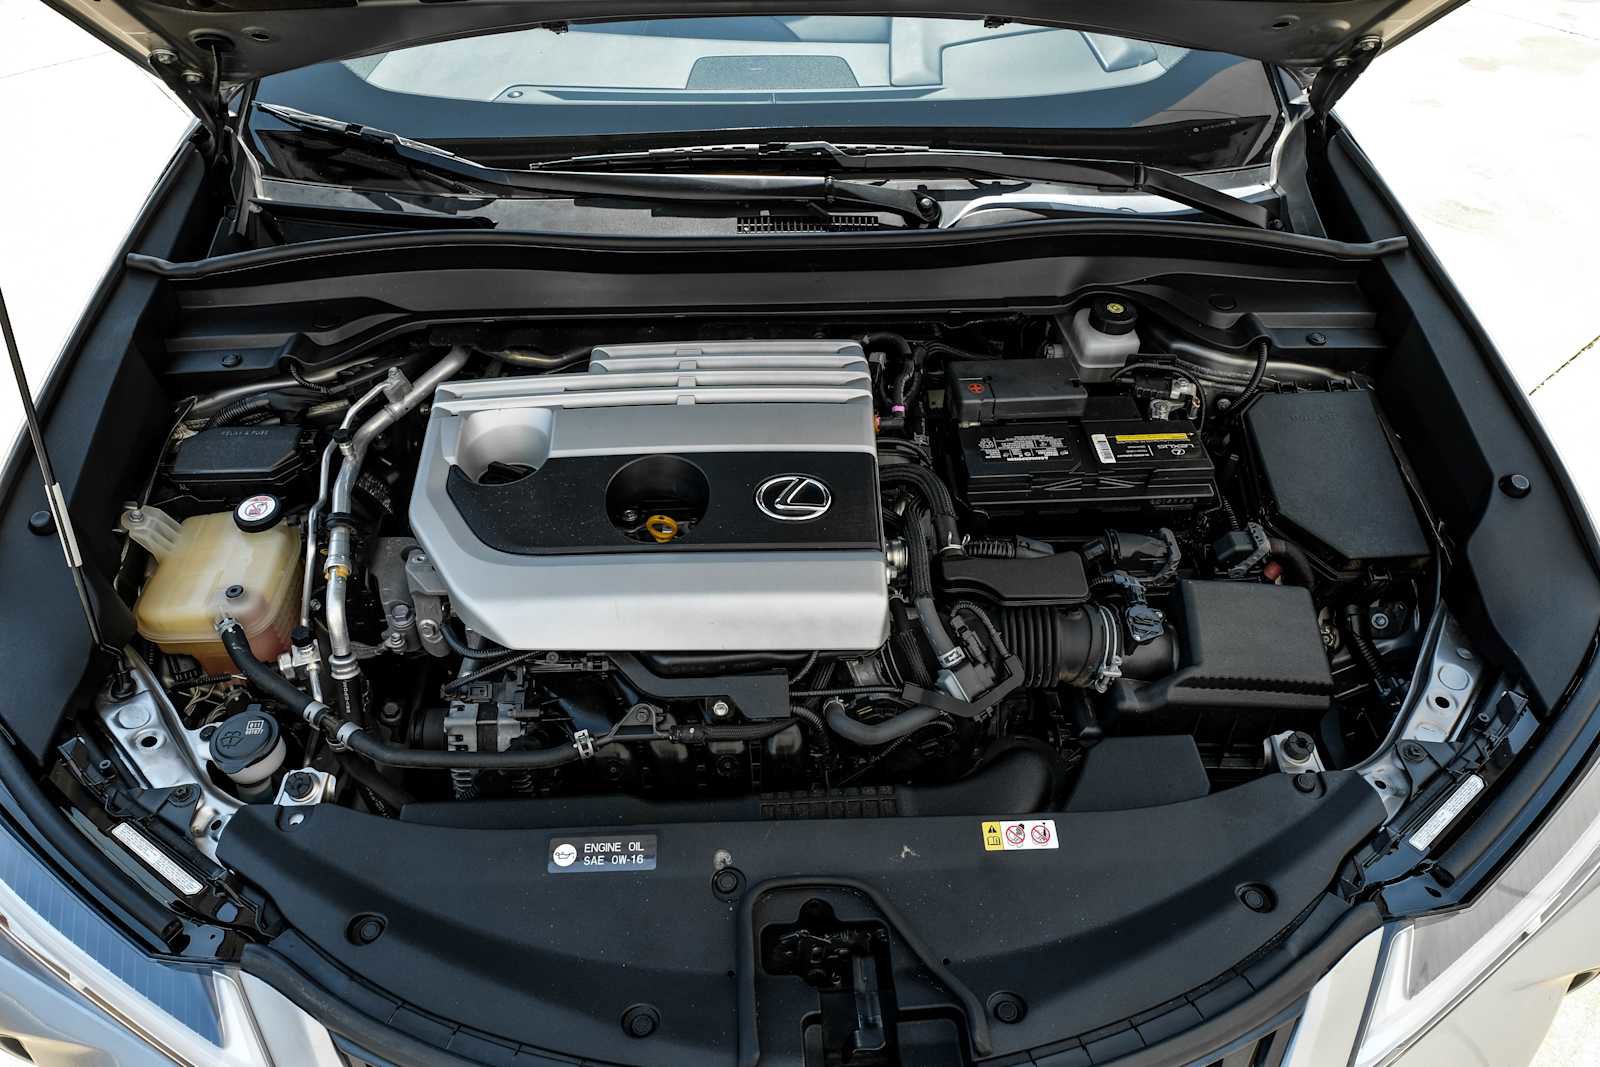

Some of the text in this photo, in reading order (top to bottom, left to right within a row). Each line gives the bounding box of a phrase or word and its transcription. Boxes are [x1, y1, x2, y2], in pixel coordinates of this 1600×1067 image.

[584, 841, 645, 853] ENGINE OIL
[583, 854, 644, 866] SAE 0W-16
